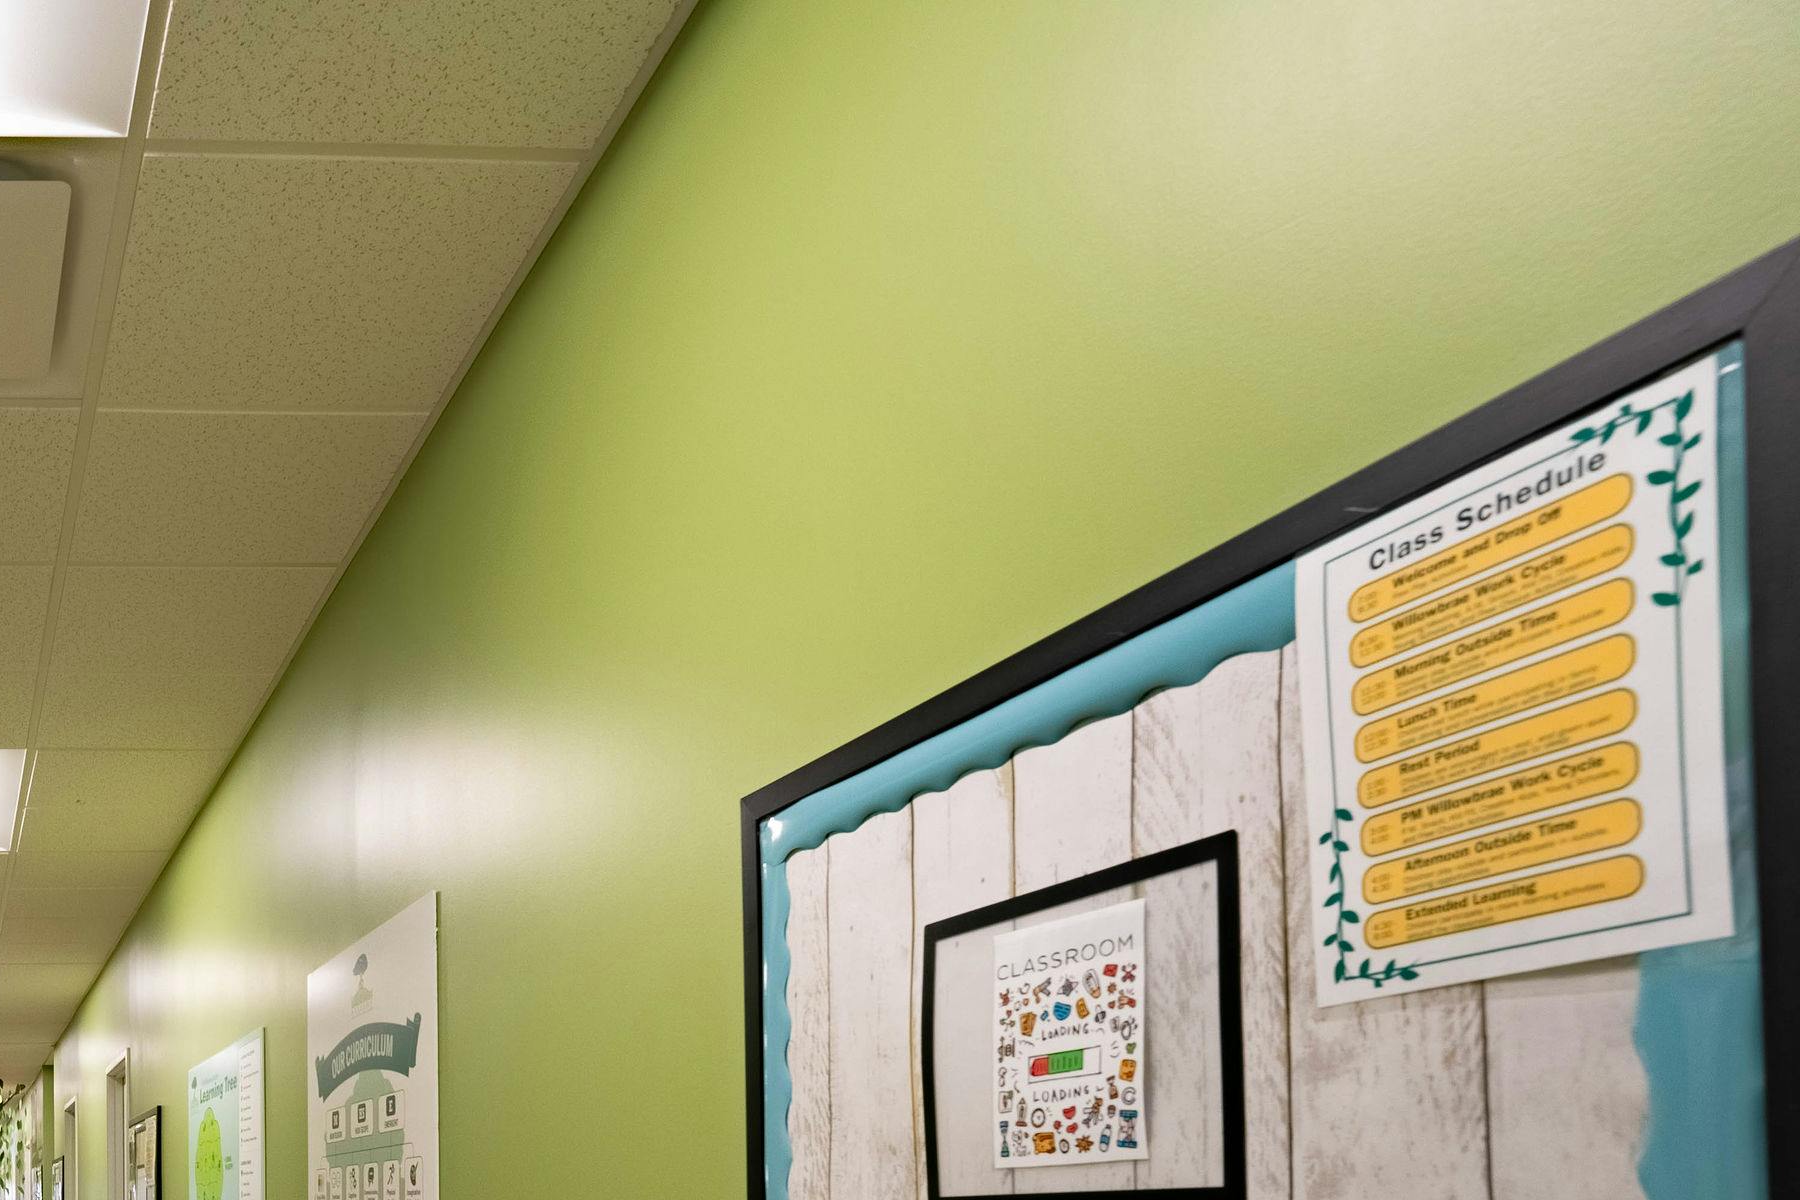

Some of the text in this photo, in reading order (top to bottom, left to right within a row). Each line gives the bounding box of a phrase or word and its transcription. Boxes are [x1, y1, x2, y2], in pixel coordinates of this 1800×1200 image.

[1369, 453, 1606, 571] Class Schedule
[1391, 555, 1457, 589] Welcome
[1463, 540, 1490, 559] and
[1495, 522, 1532, 546] Drop
[1537, 507, 1562, 526] Off
[1391, 593, 1470, 632] Willowbrae
[1474, 575, 1516, 598] Work
[1520, 554, 1567, 581] Cycle
[1393, 610, 1559, 681] Morning Outside Time
[1397, 694, 1479, 729] Lunch Time
[1399, 740, 1480, 776] Rest Period
[1401, 756, 1605, 825] PM Willowbrae Work Cycle
[1404, 818, 1578, 873] Afternoon Outside Time
[1405, 881, 1538, 921] Extended Learning
[996, 934, 1135, 981] CLASSROOM
[331, 1034, 394, 1079] OUR CURRICULUM
[200, 1082, 224, 1104] Learning
[224, 1076, 237, 1093] Tree
[1033, 1085, 1090, 1103] LOADING
